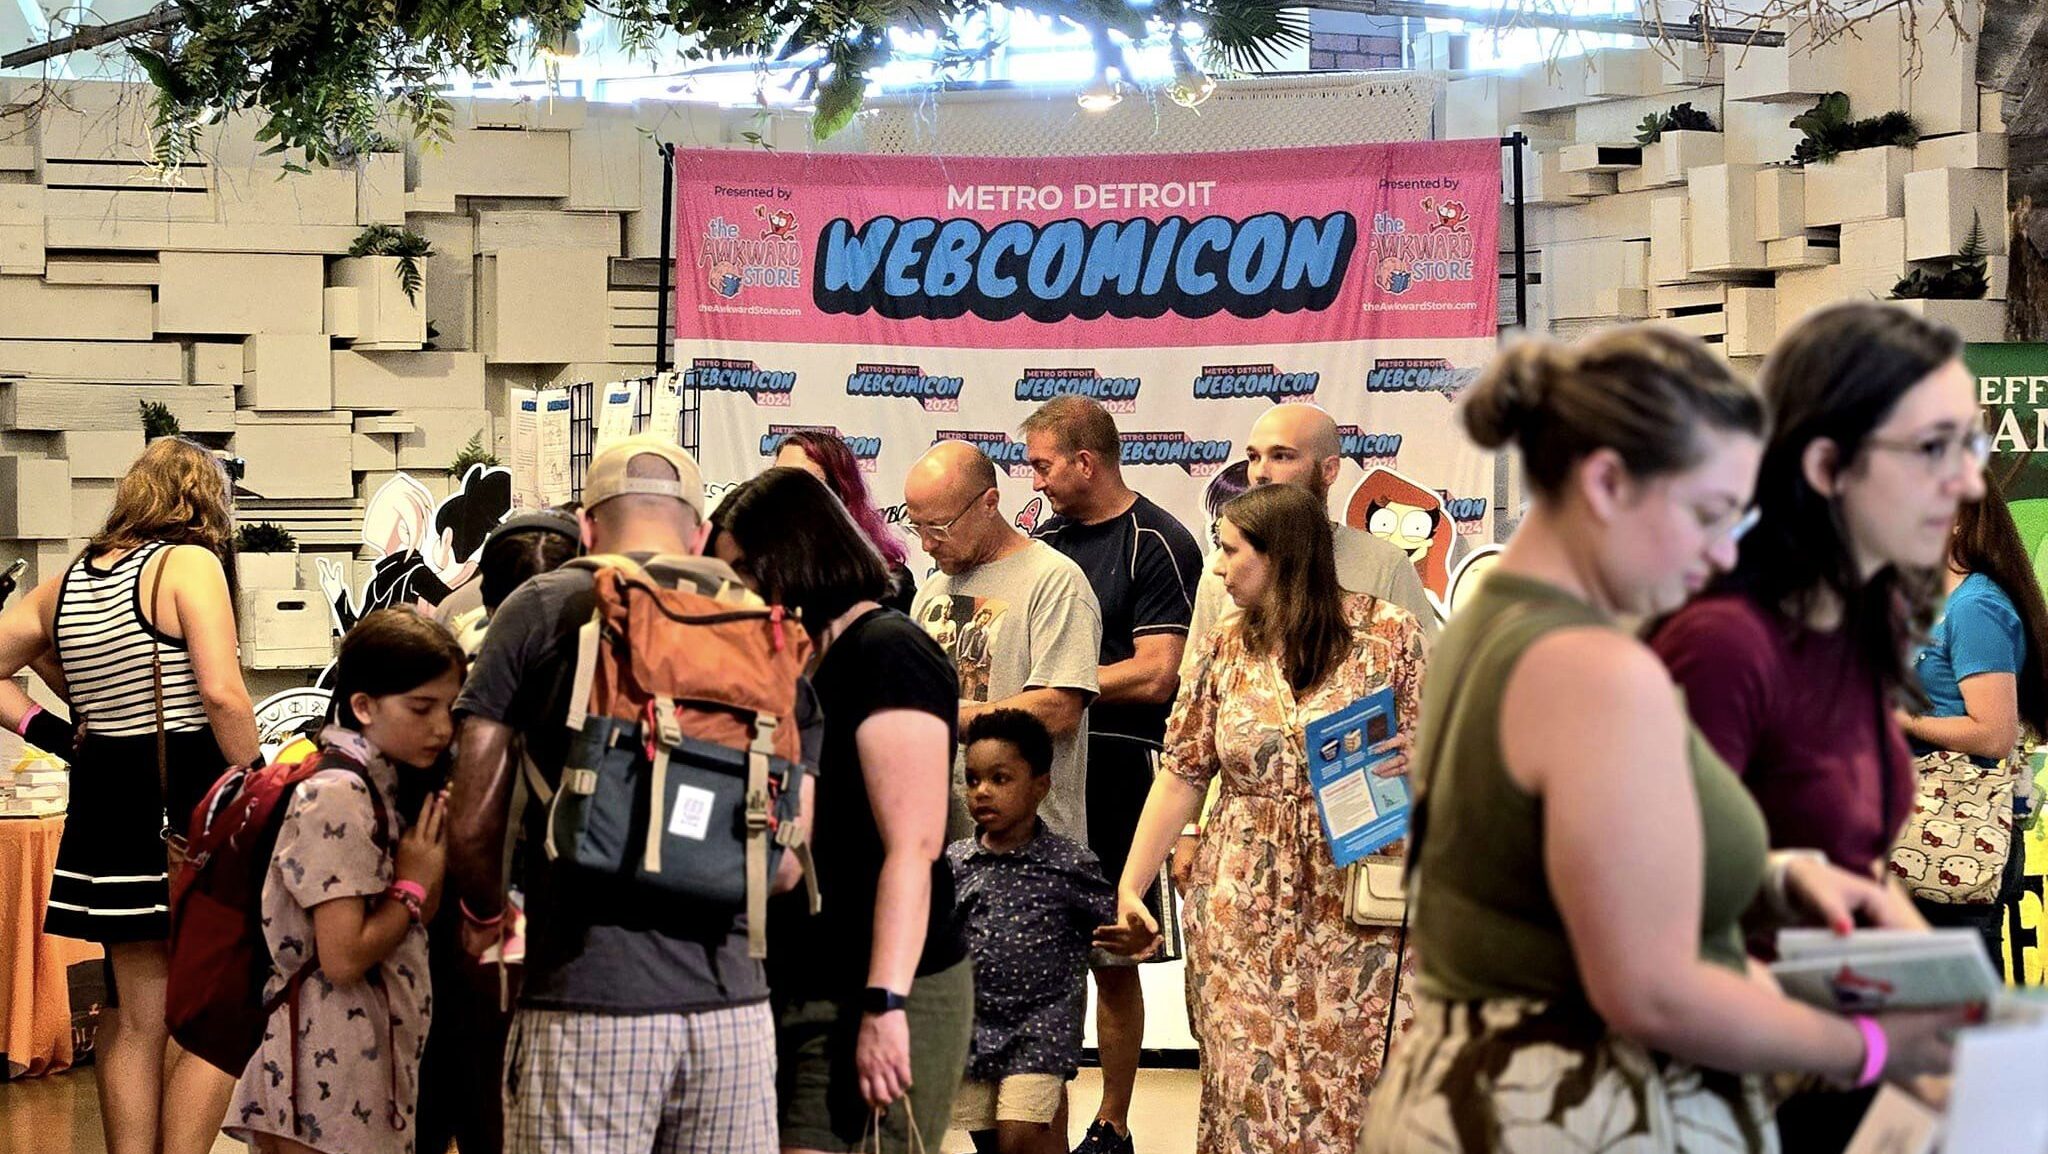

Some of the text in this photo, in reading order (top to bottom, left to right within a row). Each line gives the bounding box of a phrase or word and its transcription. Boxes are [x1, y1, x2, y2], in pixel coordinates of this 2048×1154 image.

[1379, 177, 1460, 191] Presented by
[714, 186, 792, 200] Presented by
[947, 180, 1217, 211] METRO DETROIT
[709, 217, 738, 239] the
[1375, 211, 1405, 234] the
[698, 235, 802, 268] AWKWARD
[1367, 232, 1474, 263] AWKWARD
[819, 211, 1353, 307] WEBCOMICON
[743, 266, 801, 288] STORE
[1412, 260, 1473, 281] STORE
[698, 304, 802, 317] theAwkwardStore.com
[1362, 300, 1478, 312] theAwkwardStore.com
[695, 359, 720, 367] METRO
[1026, 370, 1093, 378] METRO DETROIT
[1204, 366, 1272, 375] METRO DETROIT
[847, 374, 962, 395] WEBCOMICON
[1016, 378, 1139, 398] WEBCOMICON
[1195, 373, 1317, 395] WEBCOMICON
[756, 393, 790, 405] 2024
[925, 399, 958, 411] 2024
[939, 432, 967, 440] METRO
[1146, 433, 1183, 441] DETROIT
[1120, 440, 1230, 461] EBCOMICON
[1010, 465, 1035, 477] 202
[1190, 464, 1219, 476] 202
[1457, 522, 1482, 534] 024
